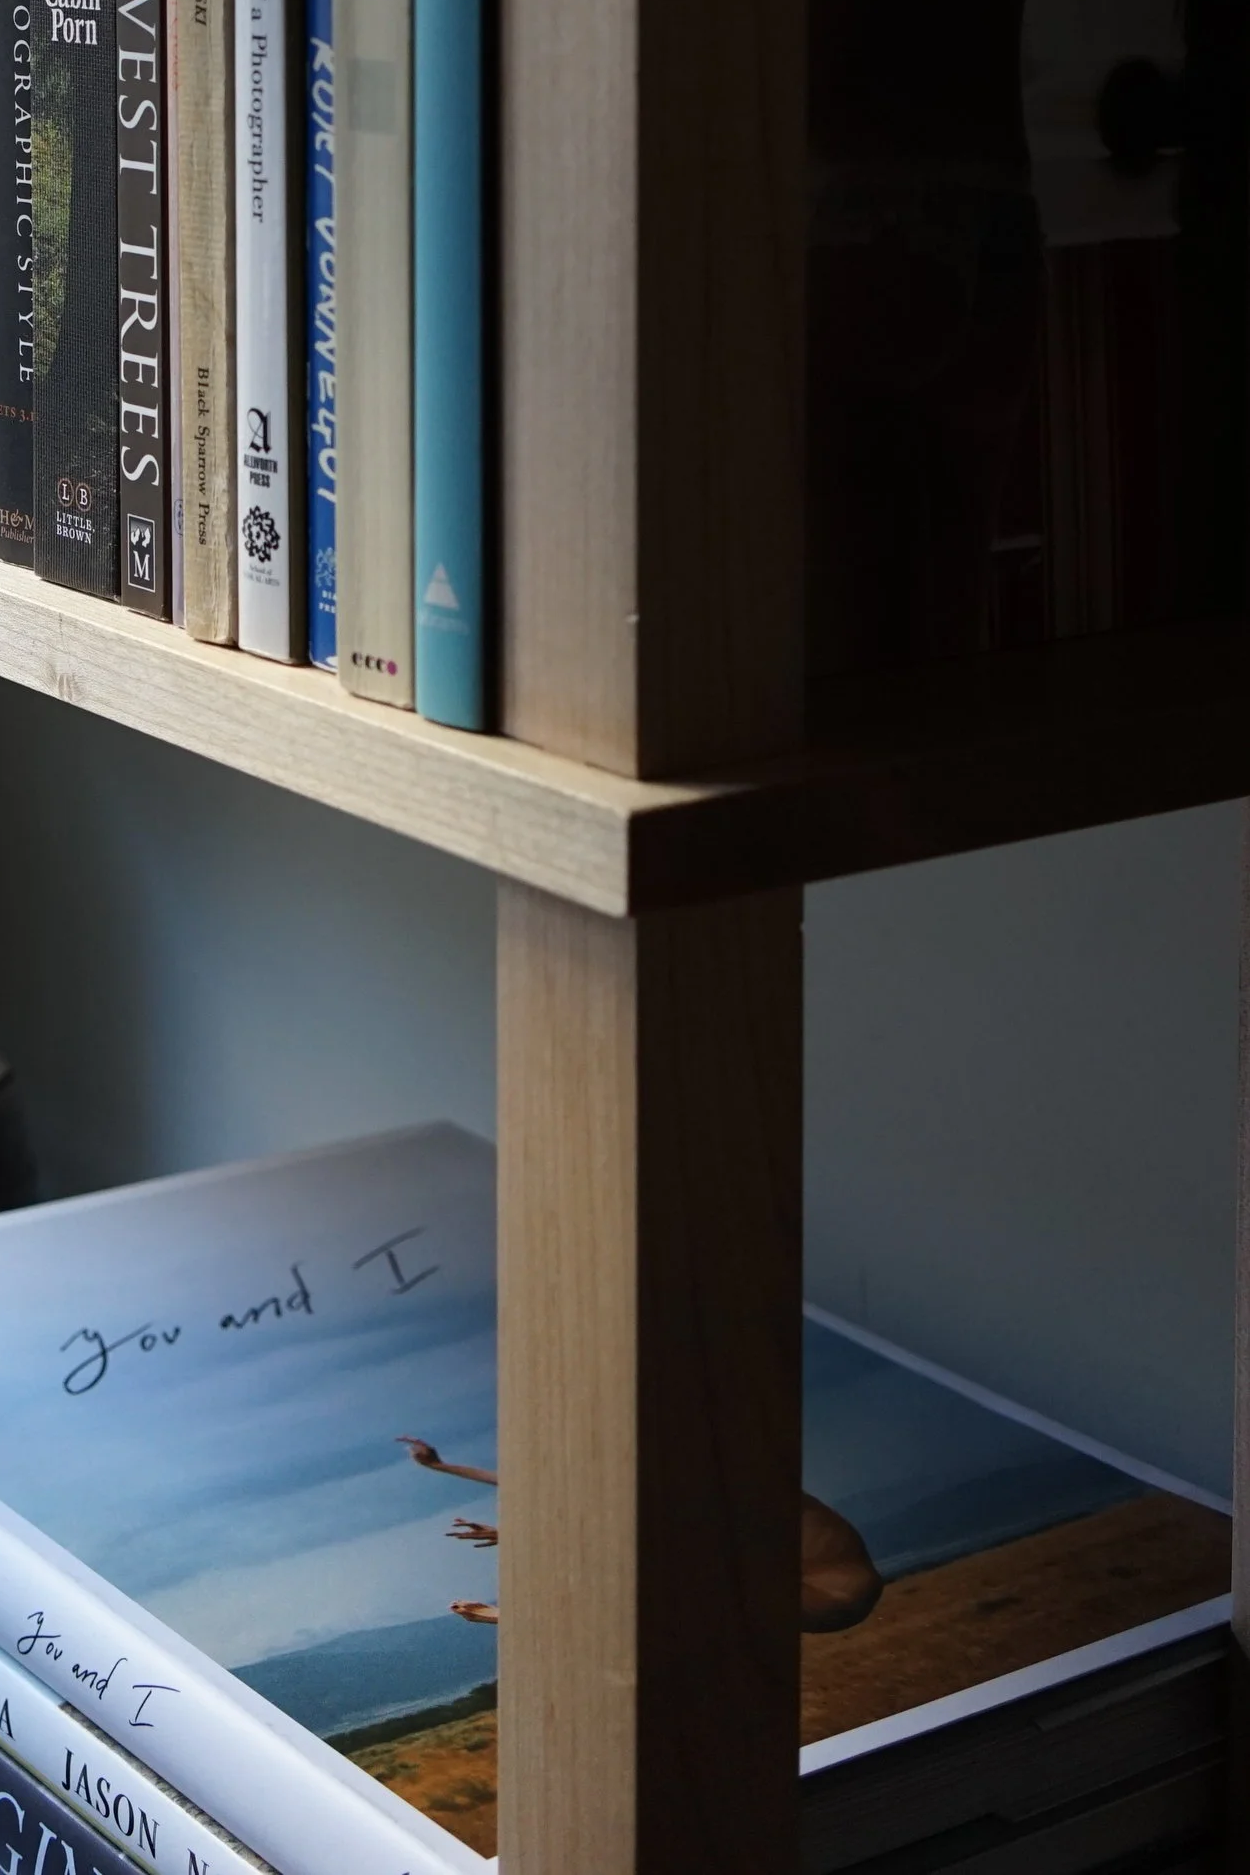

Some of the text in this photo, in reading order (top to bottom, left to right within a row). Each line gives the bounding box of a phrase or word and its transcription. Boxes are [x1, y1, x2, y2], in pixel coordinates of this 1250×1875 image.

[51, 7, 98, 45] Porn
[251, 8, 263, 21] a
[246, 34, 268, 223] Photographer
[14, 254, 34, 384] STYLE
[120, 225, 161, 489] TREES
[193, 366, 211, 546] Black Sparrow Press
[249, 470, 271, 489] PRESS
[56, 511, 95, 532] LITTLE,
[56, 524, 93, 545] BROWN
[133, 549, 150, 582] M
[60, 1228, 444, 1395] you and I
[72, 1657, 128, 1701] and
[129, 1683, 181, 1728] I
[61, 1747, 161, 1861] JASON
